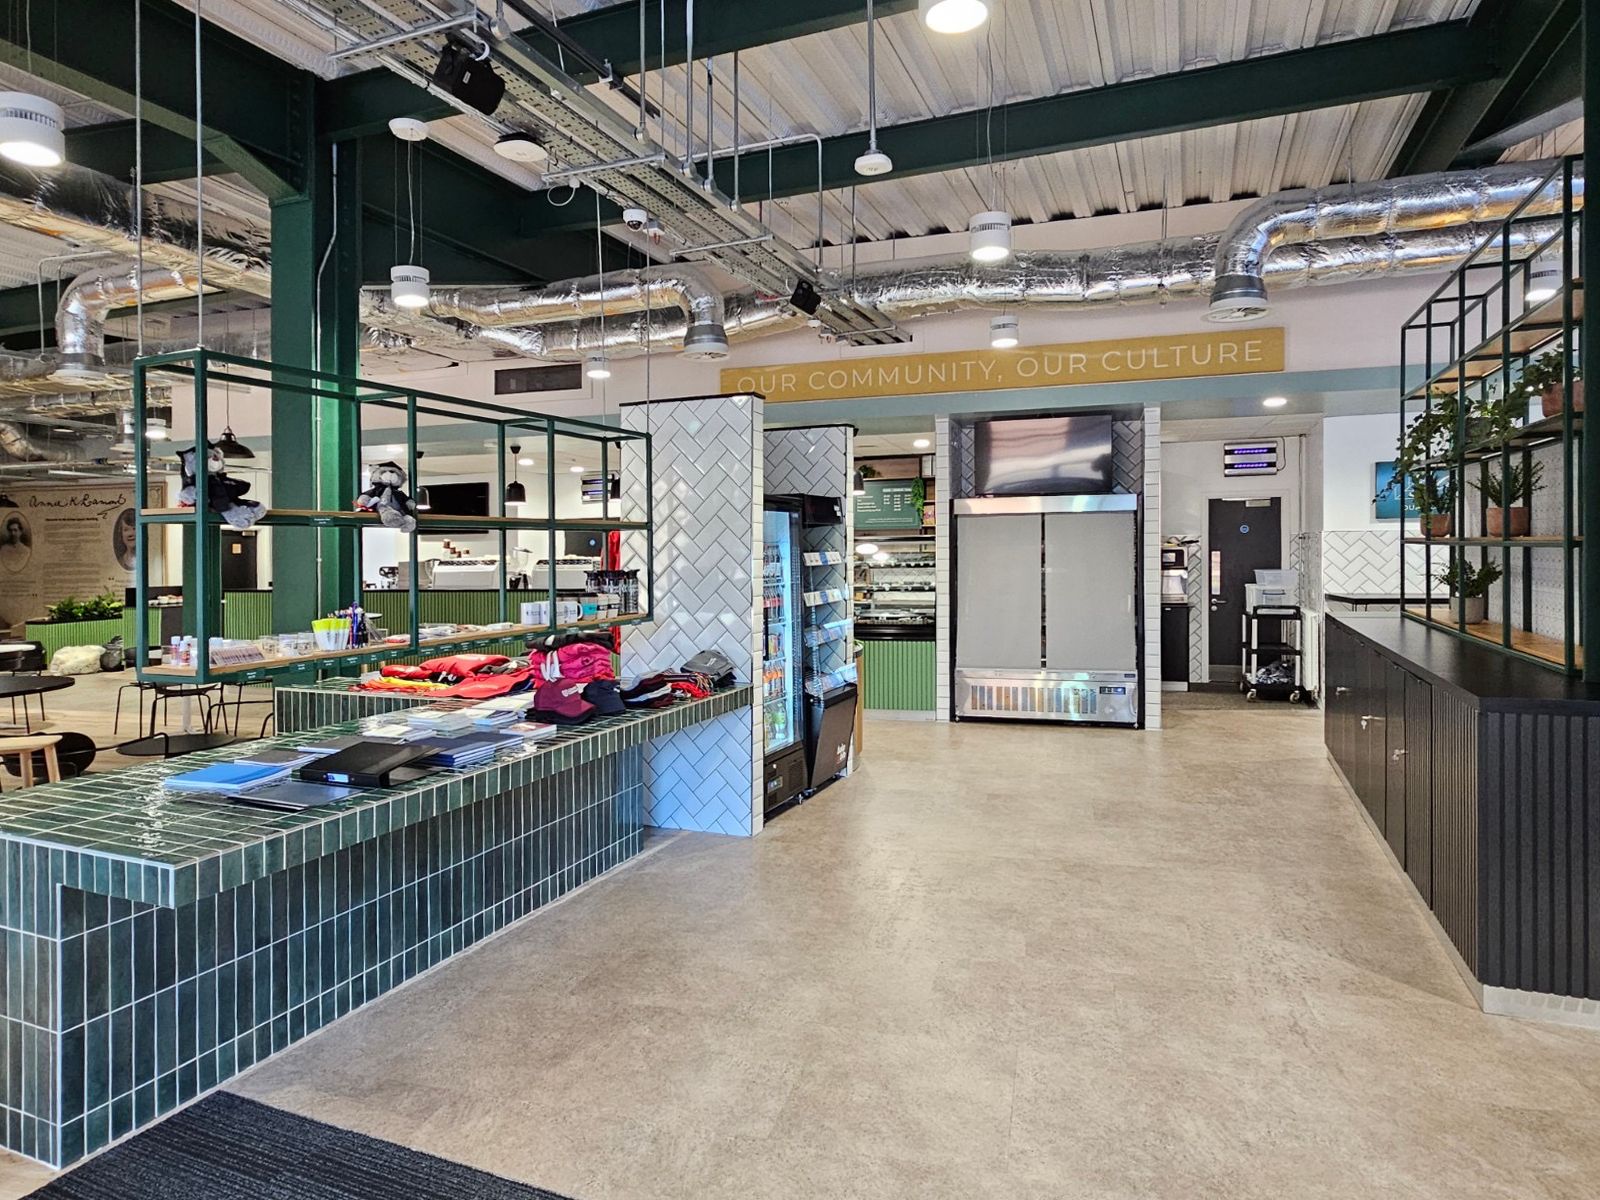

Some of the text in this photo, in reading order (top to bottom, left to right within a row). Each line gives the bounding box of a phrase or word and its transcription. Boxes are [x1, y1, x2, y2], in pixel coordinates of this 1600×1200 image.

[737, 340, 1263, 394] OUR COMMUNITY, OUR CULTURE
